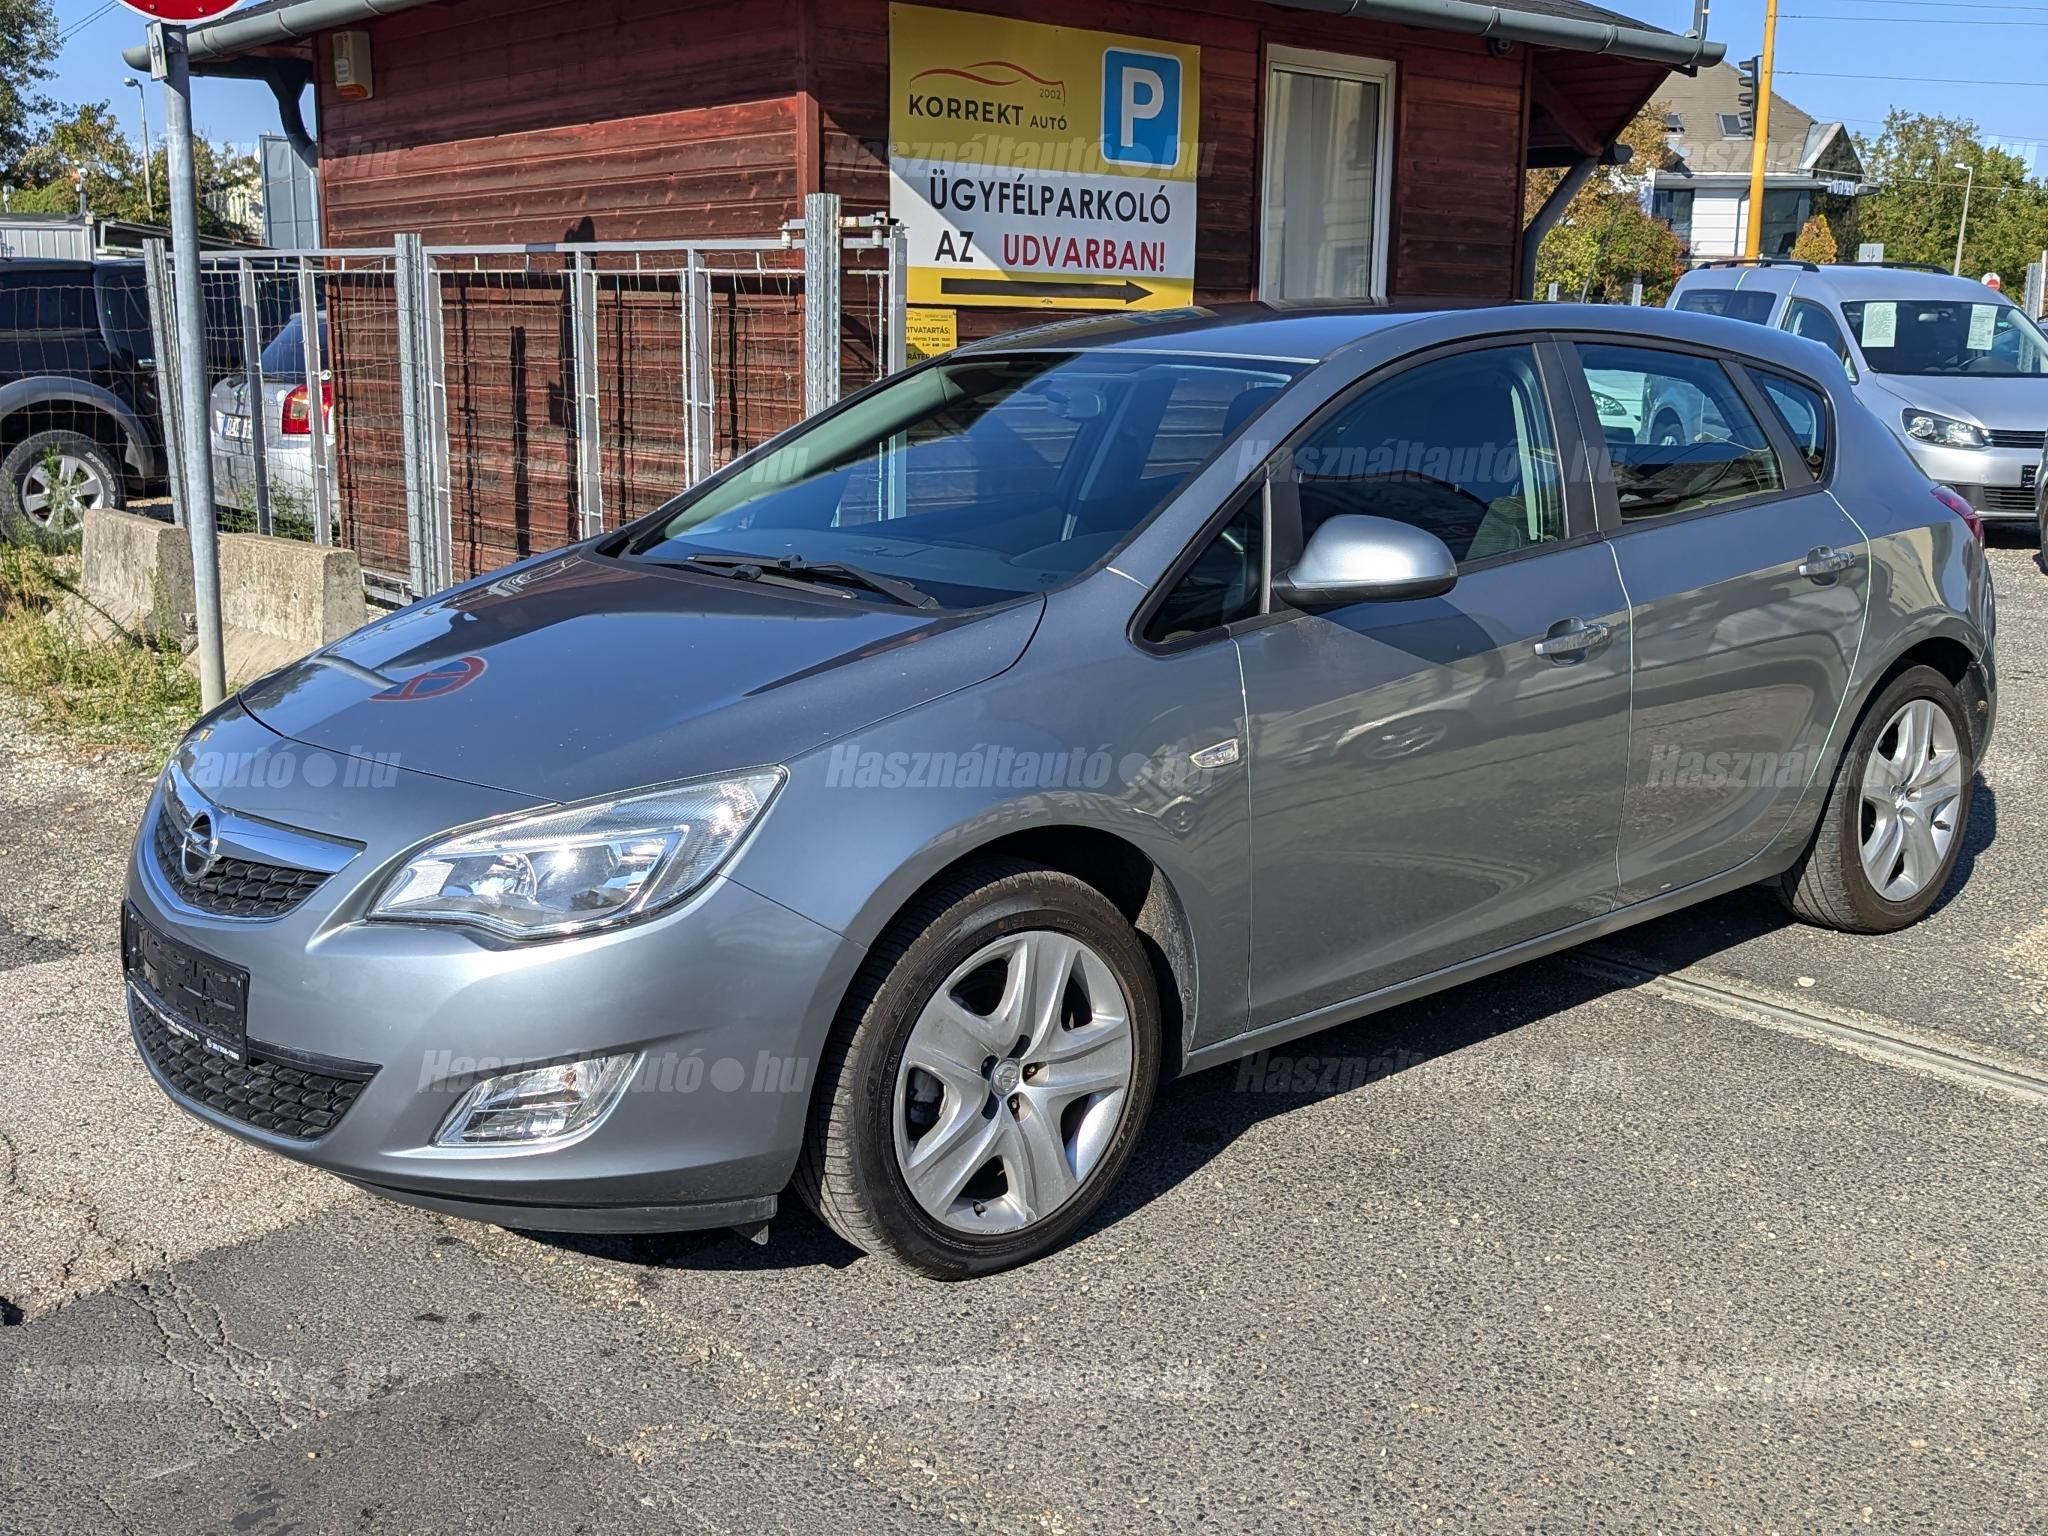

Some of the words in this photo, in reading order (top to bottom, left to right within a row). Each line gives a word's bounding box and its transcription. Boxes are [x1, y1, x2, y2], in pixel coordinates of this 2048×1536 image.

[908, 94, 1024, 126] KORREKT
[1029, 114, 1067, 130] AUTÓ
[1039, 87, 1062, 100] 2002
[1120, 66, 1164, 148] P
[930, 168, 1171, 224] ÜGYFÉLPARKOLÓ
[934, 230, 974, 263] AZ
[1003, 233, 1165, 272] UDVARBAN!
